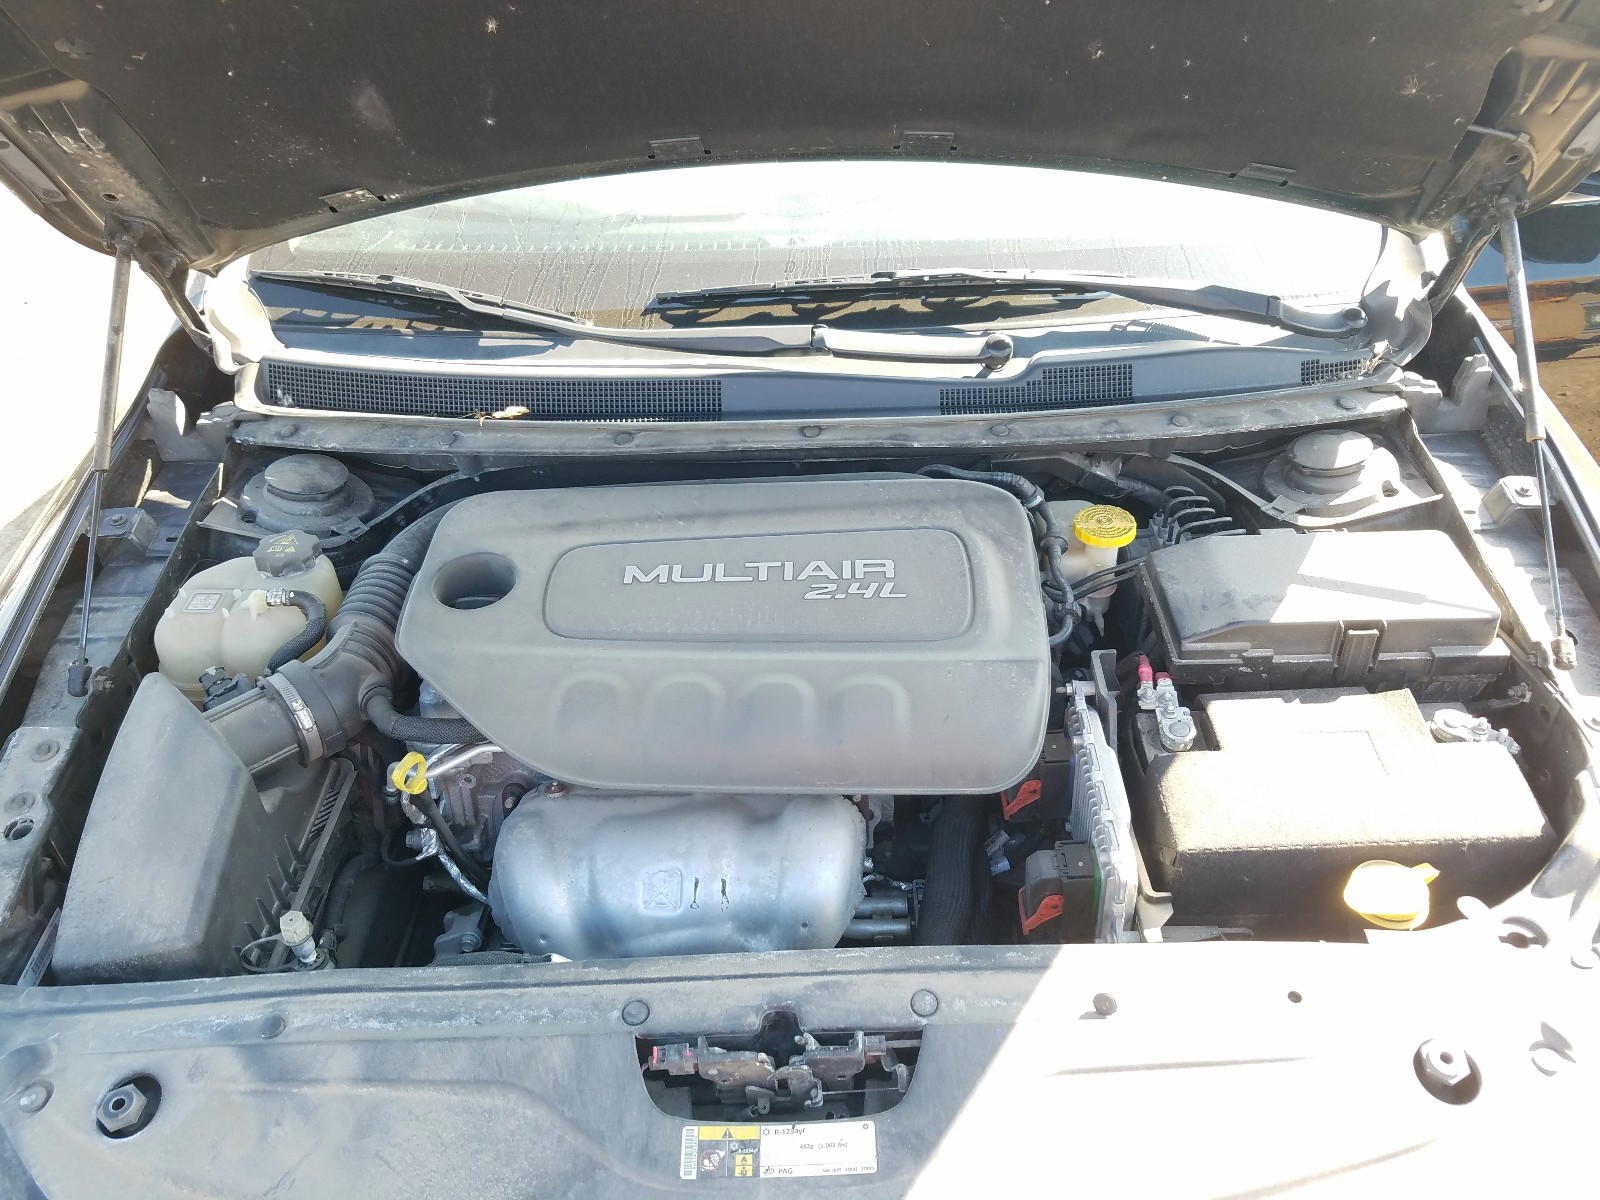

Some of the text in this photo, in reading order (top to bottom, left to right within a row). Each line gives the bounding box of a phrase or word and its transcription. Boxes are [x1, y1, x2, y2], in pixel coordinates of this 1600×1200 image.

[623, 559, 895, 584] MULTIAIR
[803, 582, 908, 600] 2.4L
[778, 1167, 793, 1175] PAG
